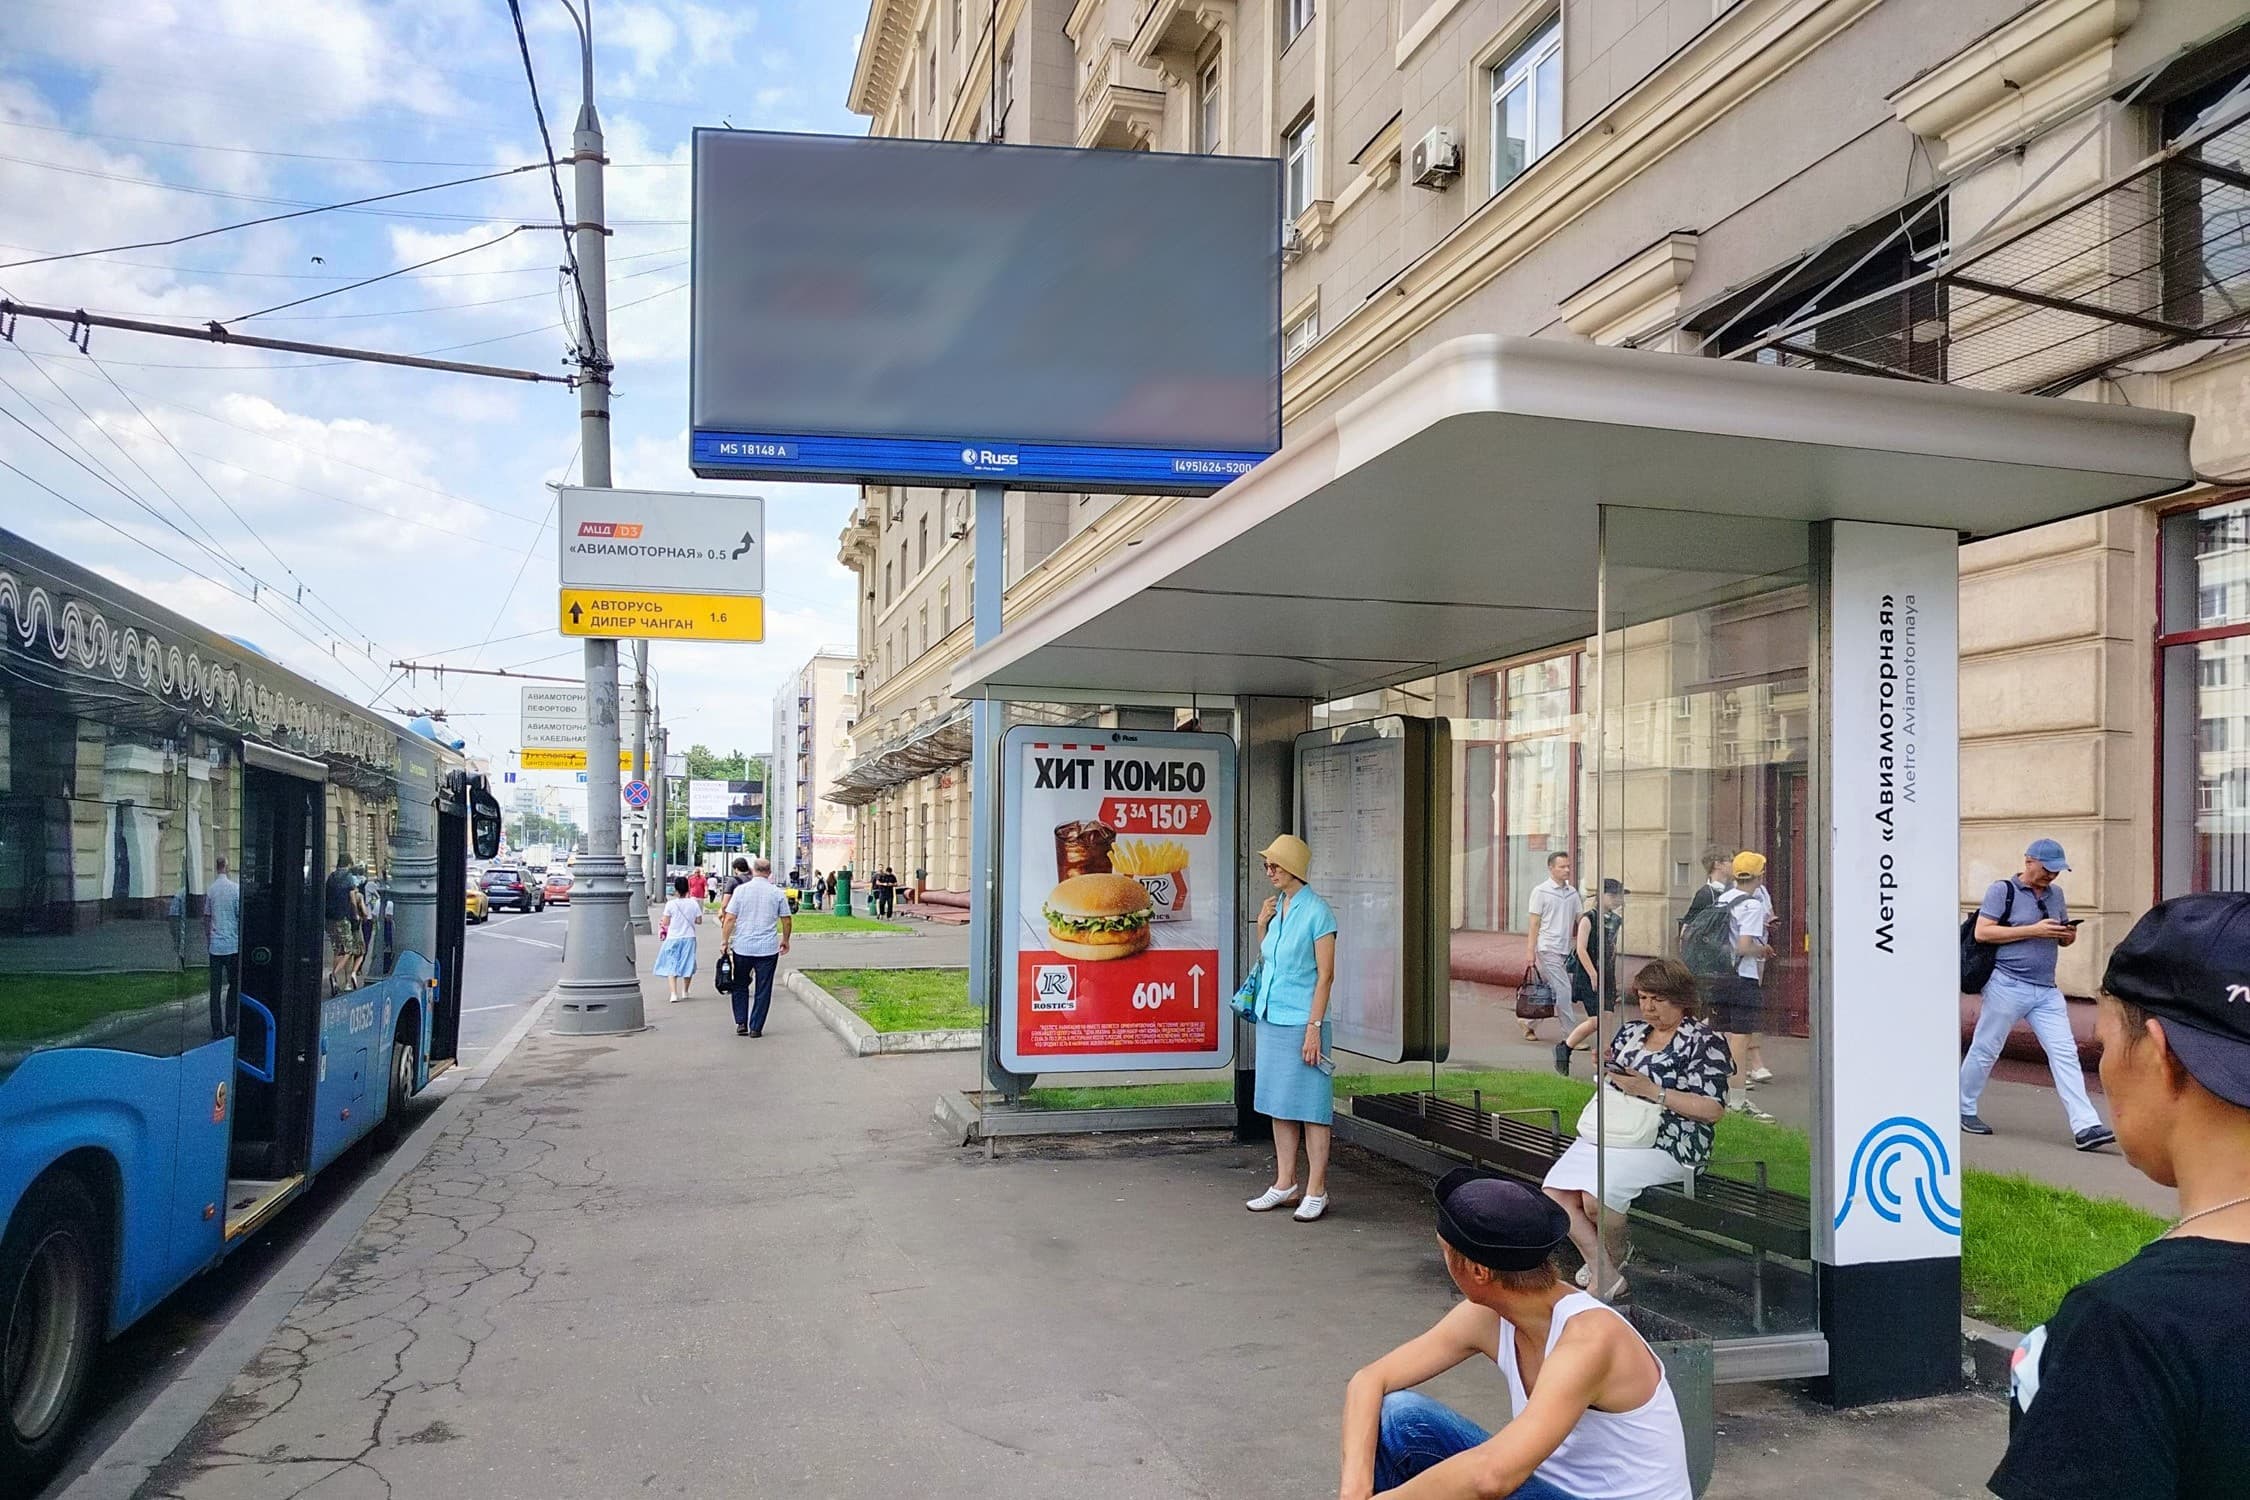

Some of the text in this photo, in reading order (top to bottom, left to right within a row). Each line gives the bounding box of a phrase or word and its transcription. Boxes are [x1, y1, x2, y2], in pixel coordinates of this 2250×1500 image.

[720, 444, 786, 456] MS 18148 A
[980, 450, 1019, 465] Russ
[1175, 459, 1252, 473] (495)626-5200
[582, 524, 638, 537] МЦД D3
[569, 543, 727, 560] «АВИАМОТОРНАЯ» 0.5
[591, 600, 663, 613] АВТОРУСЬ
[590, 616, 693, 629] ДИЛЕР ЧАНГАН
[710, 612, 728, 623] 1.6
[1902, 594, 1918, 803] Metro Aviamotornaya
[1034, 757, 1206, 793] ХИТ КОМБО
[1875, 593, 1898, 954] Метро «Авиамоторная»
[1113, 803, 1128, 829] 3
[1130, 803, 1147, 819] ЗА
[1033, 1002, 1075, 1010] ROSTIC'S
